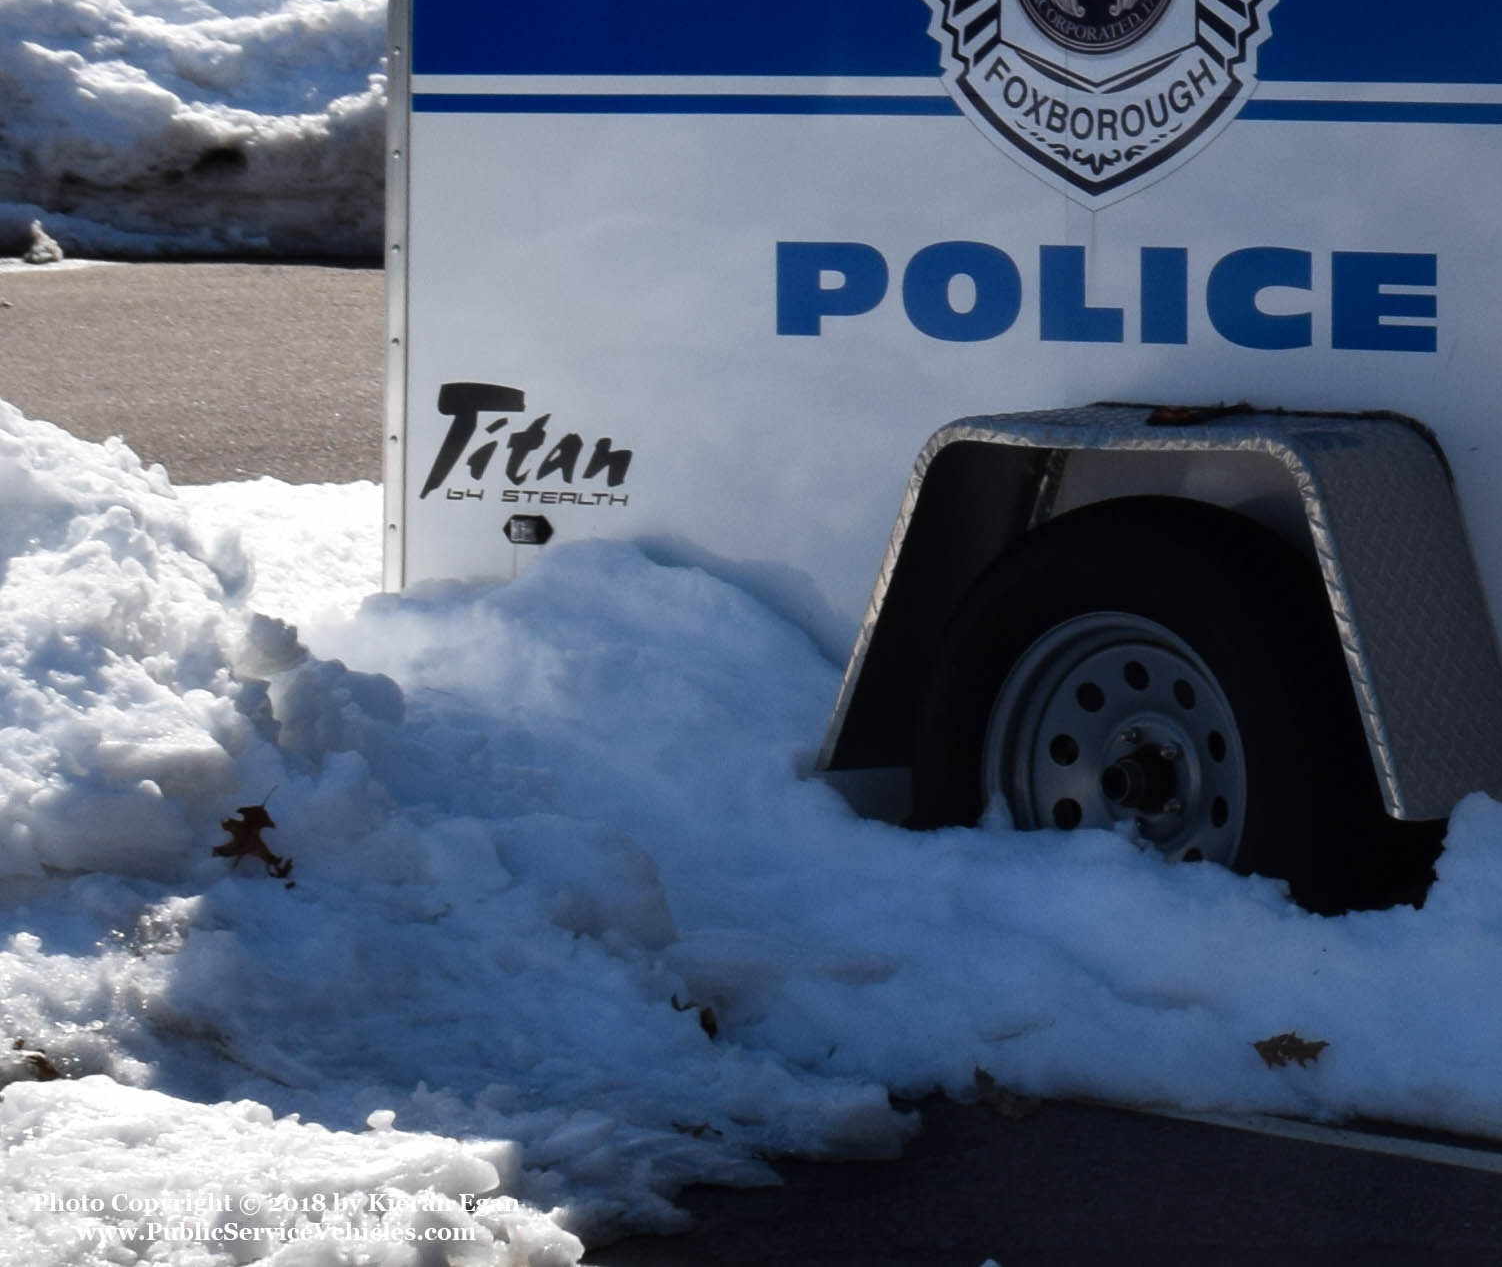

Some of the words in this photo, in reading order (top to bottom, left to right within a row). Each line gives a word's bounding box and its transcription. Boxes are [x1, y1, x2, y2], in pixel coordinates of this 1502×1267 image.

[982, 58, 1219, 142] FOXBOROUGH
[775, 240, 1438, 353] POLICE
[419, 381, 633, 501] Titan
[500, 489, 629, 507] STEALTH
